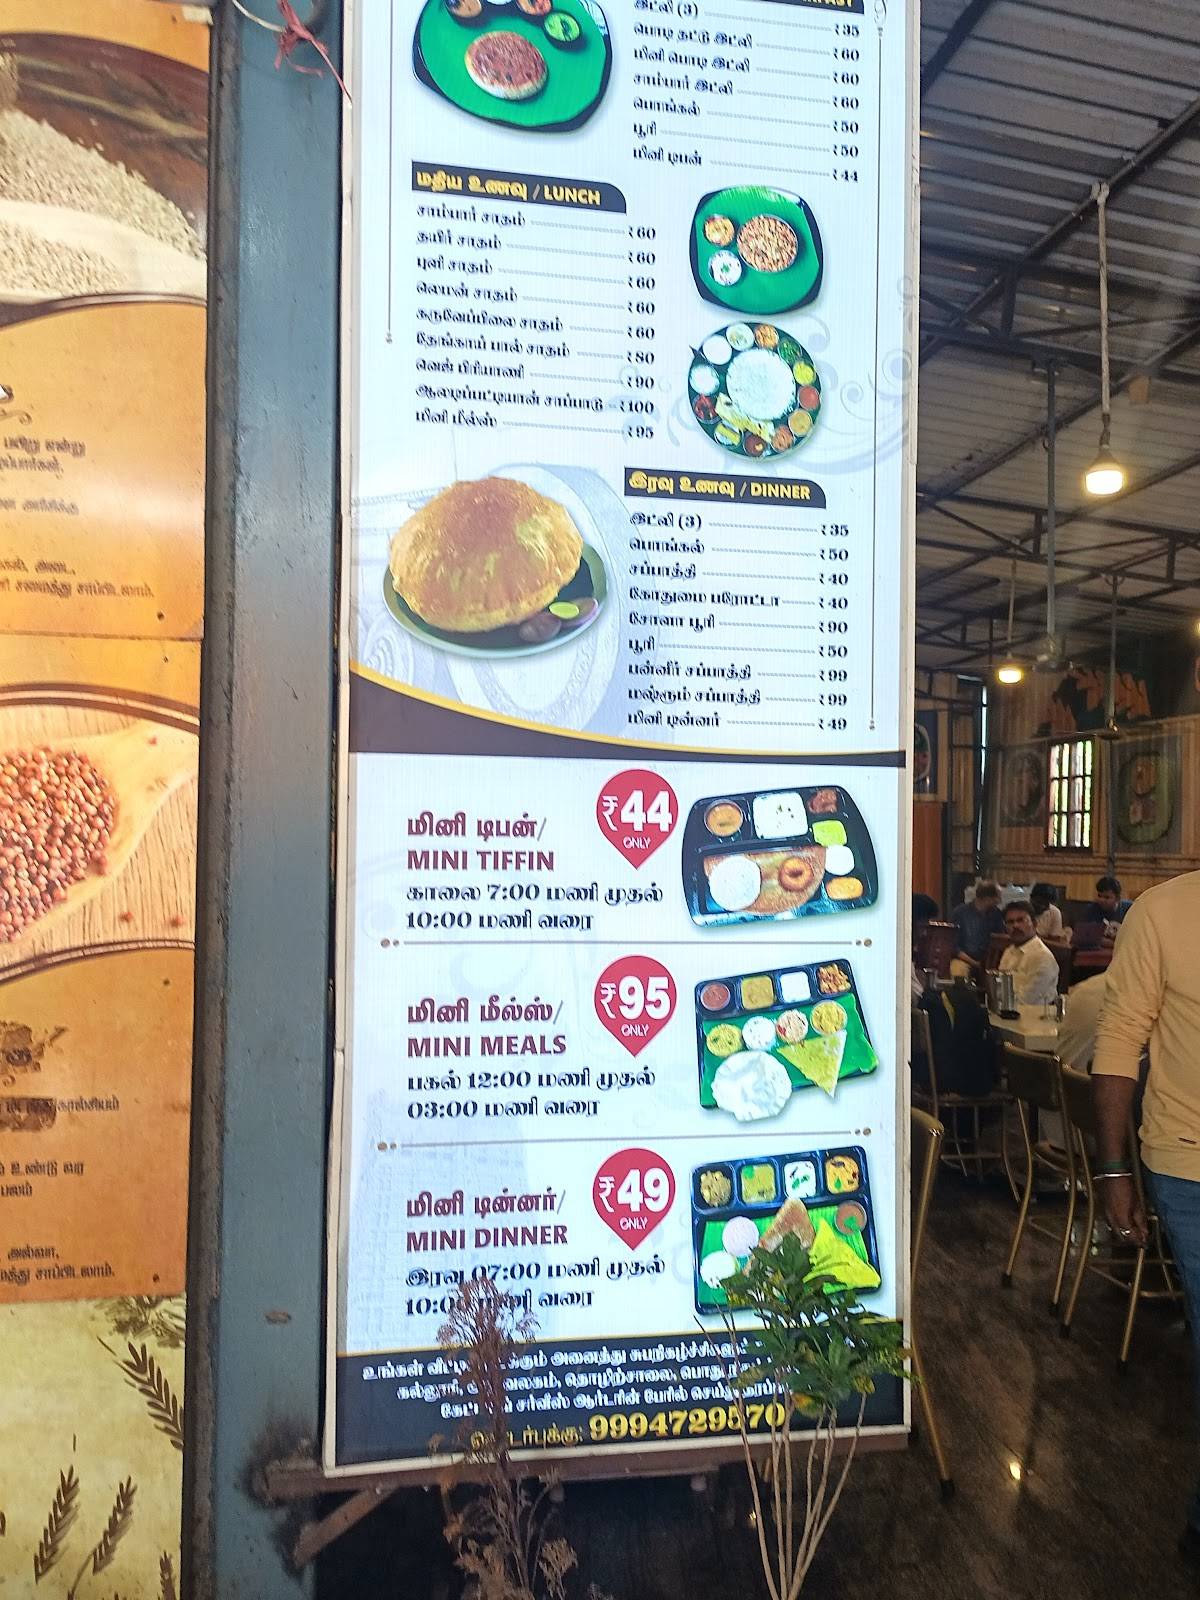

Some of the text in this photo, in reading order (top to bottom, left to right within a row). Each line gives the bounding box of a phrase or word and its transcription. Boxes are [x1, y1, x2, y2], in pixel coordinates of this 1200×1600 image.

[714, 32, 753, 49] இட்லி
[634, 48, 664, 63] மினி
[711, 56, 750, 73] இட்லி
[634, 72, 689, 90] சாம்பார்
[695, 78, 733, 95] இட்லி
[634, 96, 701, 116] பொங்கல்
[634, 121, 657, 139] பூரி
[634, 145, 664, 161] மினி
[668, 150, 702, 167] டிபன்
[468, 175, 527, 200] உணவு
[544, 185, 600, 205] LUNCH
[417, 202, 477, 223] சாம்பார்
[481, 210, 526, 227] சாதம்
[456, 234, 502, 251] சாதம்
[448, 259, 493, 276] சாதம்
[473, 286, 518, 302] சாதம்
[519, 316, 563, 332] சாதம்
[417, 331, 487, 350] தேங்காய்
[491, 338, 523, 353] பால்
[526, 342, 570, 359] சாதம்
[457, 360, 524, 379] பிரியாணி
[544, 392, 603, 412] சாப்பாடு
[415, 407, 449, 424] மினி
[629, 471, 674, 495] இரவு
[680, 476, 734, 499] உணவு
[751, 482, 811, 500] DINNER
[630, 512, 674, 527] இட்லி
[629, 536, 705, 554] பொங்கல்
[629, 560, 697, 581] சப்பாத்தி
[629, 586, 707, 605] கோதுமை
[711, 591, 779, 607] பரோட்டா
[689, 614, 715, 633] பூரி
[628, 636, 655, 655] பூரி
[685, 662, 751, 682] சப்பாத்தி
[695, 688, 761, 707] சப்பாத்தி
[628, 710, 663, 726] மினி
[666, 711, 721, 729] டின்னர்
[407, 811, 466, 837] மினி
[623, 837, 651, 849] ONLY
[407, 851, 555, 871] MINI TIFFIN
[406, 882, 663, 907] காலை 7:00 மணி முதல்
[406, 909, 593, 931] 10:00 மணி வரை
[407, 997, 469, 1023] மினி
[621, 1024, 650, 1037] ONLY
[407, 1035, 567, 1058] MINI MEALS
[407, 1066, 656, 1092] பகல் 12:00 மணி முதல்
[407, 1097, 600, 1119] 03:00 மணி வரை
[406, 1190, 464, 1217] மினி
[619, 1216, 648, 1230] ONLY
[406, 1225, 568, 1252] MINI DINNER
[406, 1255, 666, 1287] இரவு 07:00 மணி முதல்
[538, 1291, 594, 1306] வரை
[363, 1359, 424, 1380] உங்கள்
[589, 1402, 785, 1441] 9994729570
